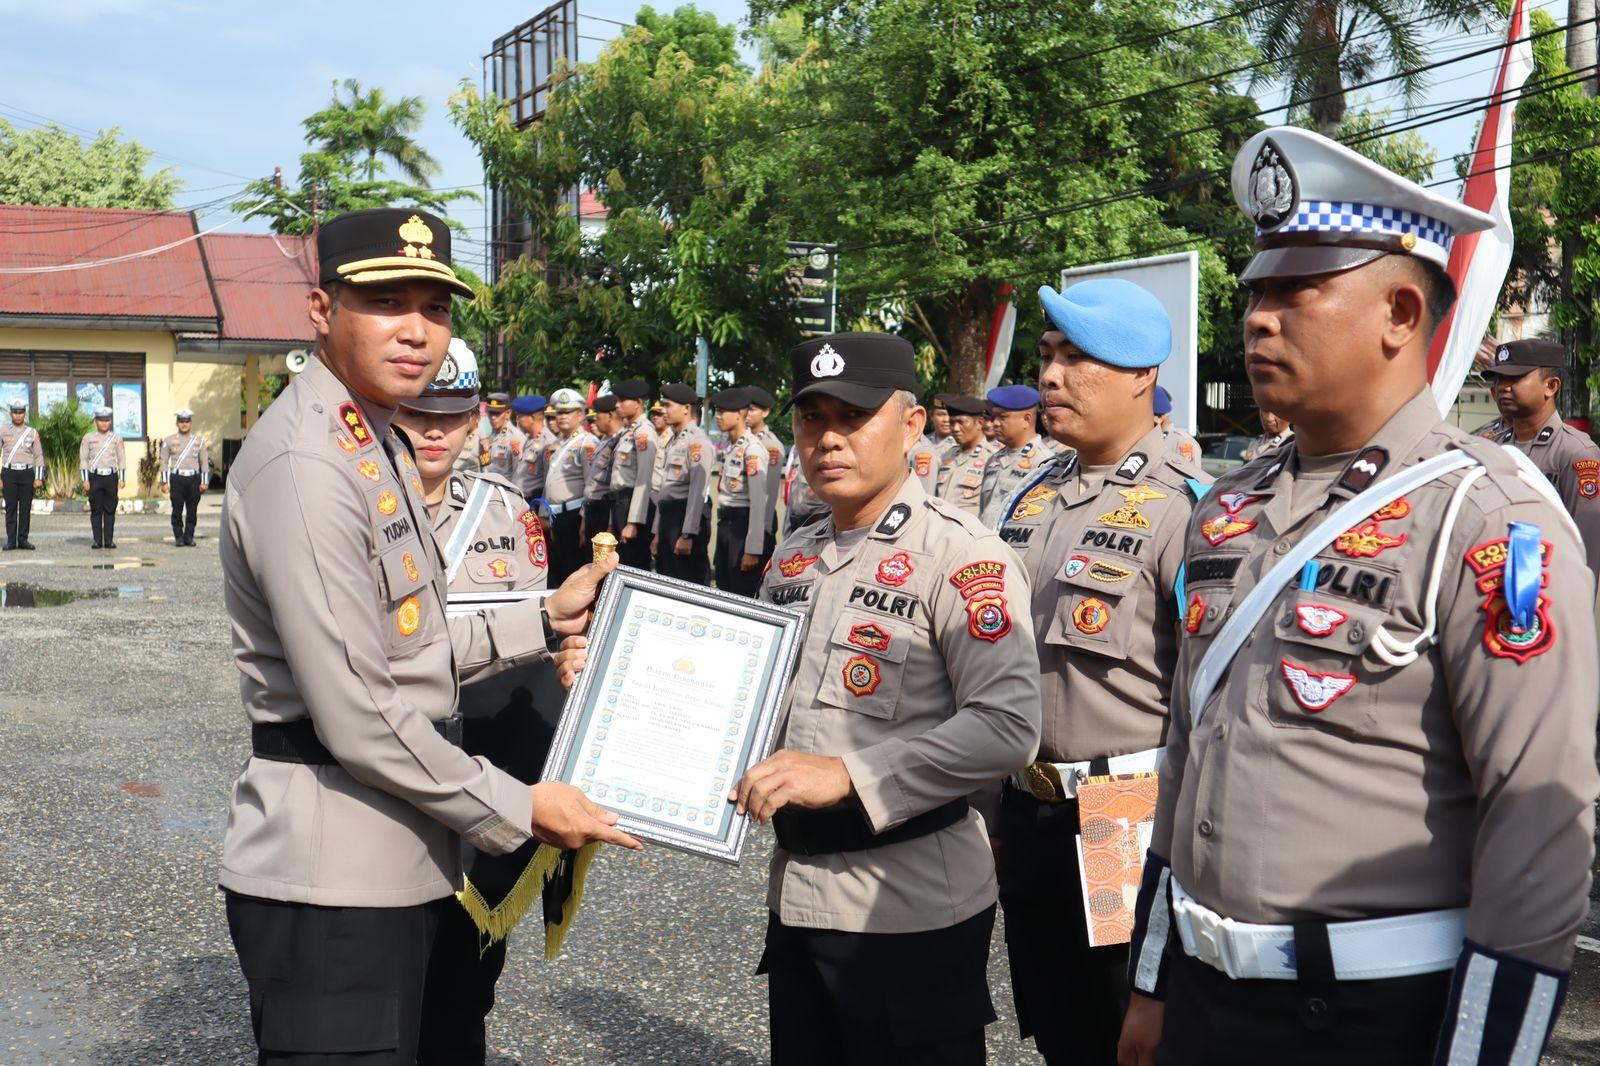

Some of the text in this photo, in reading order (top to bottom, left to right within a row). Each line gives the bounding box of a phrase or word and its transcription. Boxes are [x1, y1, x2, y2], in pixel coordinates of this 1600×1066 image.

[382, 517, 411, 543] YUDHA
[1081, 530, 1143, 556] POLRI
[1474, 542, 1546, 563] POLS
[956, 562, 1001, 581] POLRES
[1296, 563, 1391, 605] OLRI
[849, 586, 918, 619] POLRI
